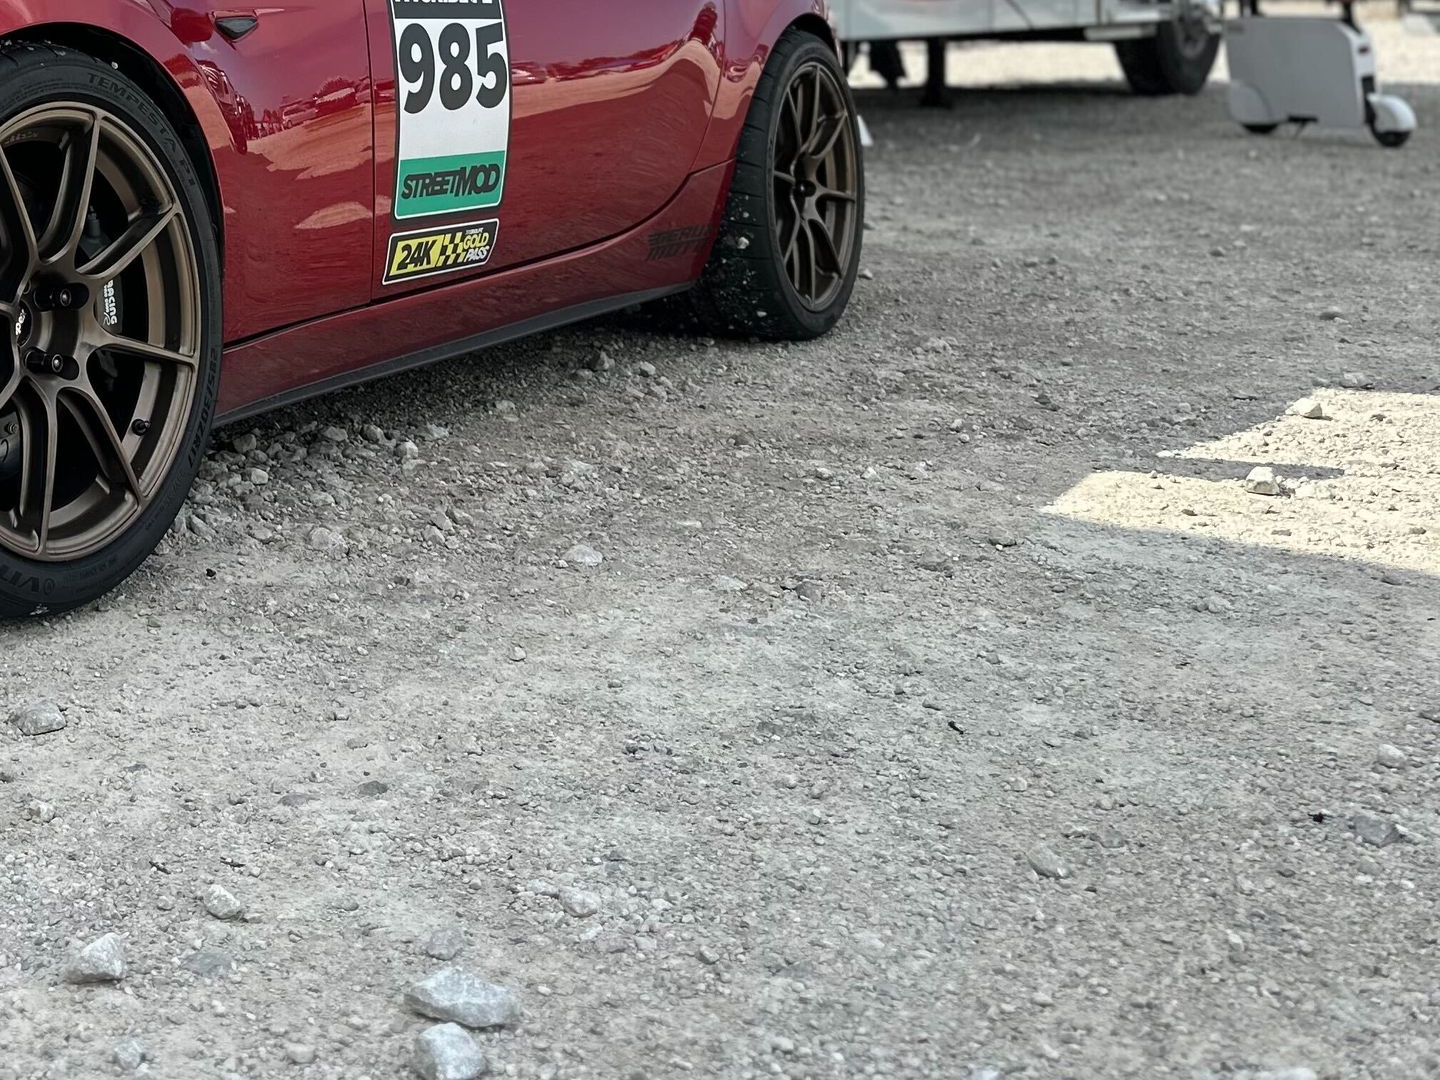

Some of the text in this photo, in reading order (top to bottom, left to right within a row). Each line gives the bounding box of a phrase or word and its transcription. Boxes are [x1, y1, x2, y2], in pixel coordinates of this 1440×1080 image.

[399, 21, 507, 114] 985
[463, 232, 489, 249] GOLD
[396, 239, 437, 271] 24K
[464, 246, 490, 262] PASS
